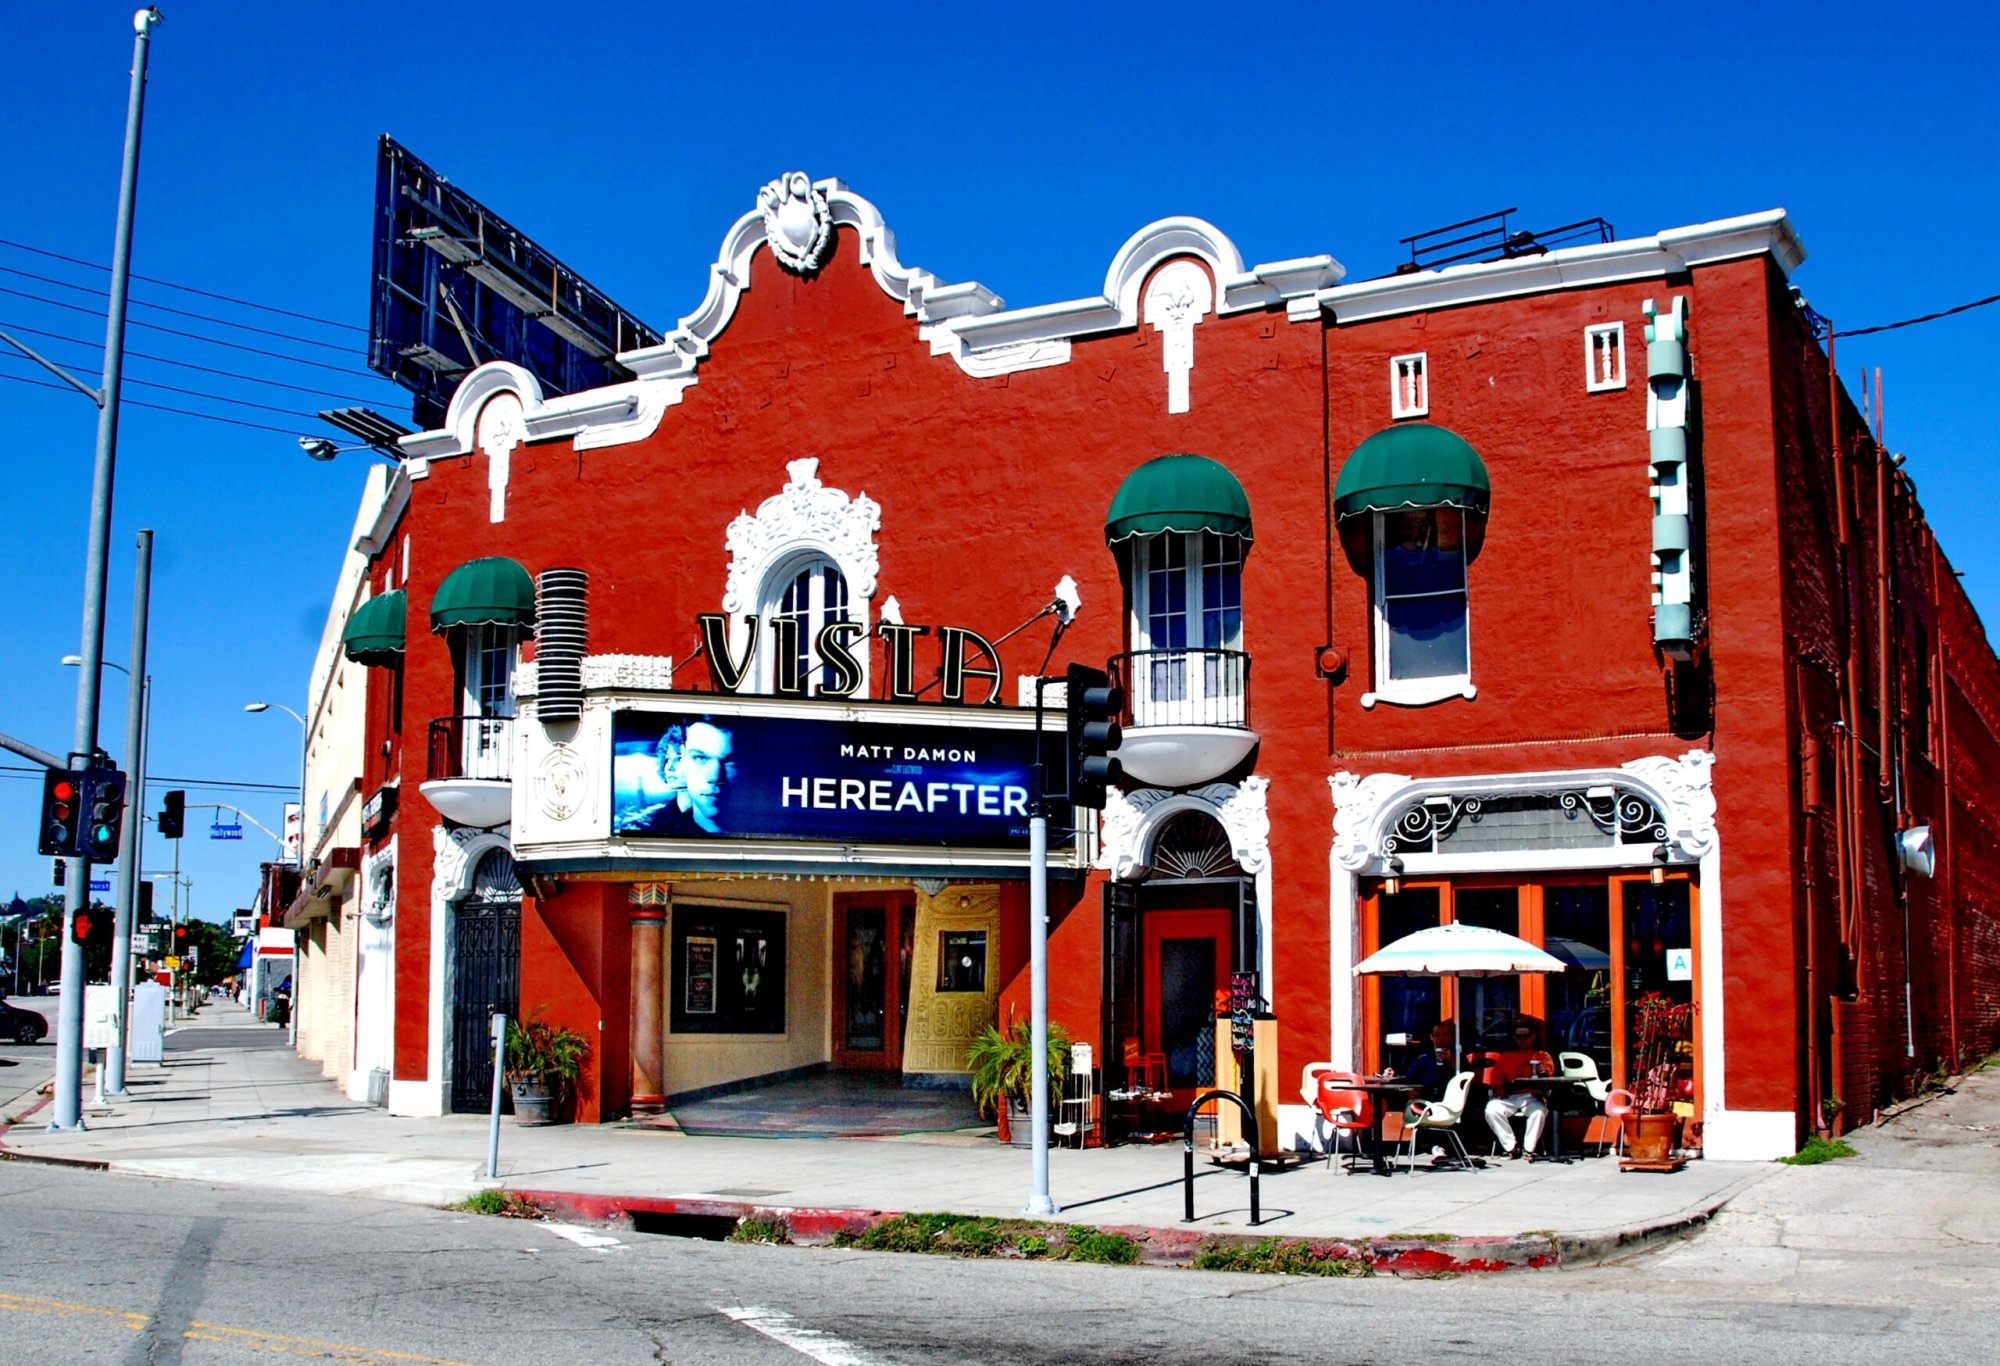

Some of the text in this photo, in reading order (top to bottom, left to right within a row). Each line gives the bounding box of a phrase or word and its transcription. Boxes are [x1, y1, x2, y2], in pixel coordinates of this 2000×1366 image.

[700, 612, 1004, 704] VISTA
[841, 744, 977, 763] MATT DAMON
[782, 776, 1029, 817] HEREAFTER
[1674, 955, 1687, 970] A
